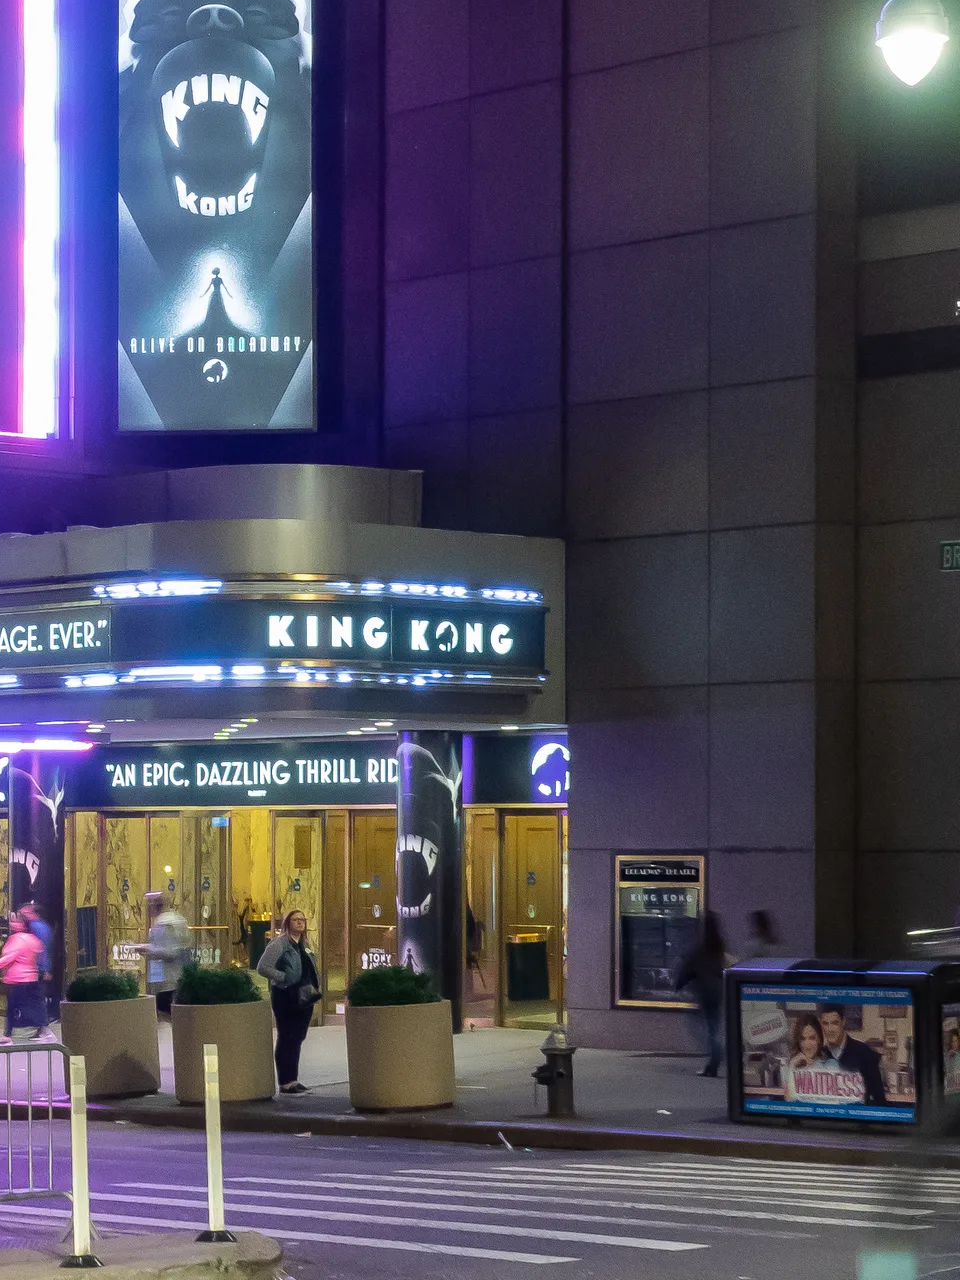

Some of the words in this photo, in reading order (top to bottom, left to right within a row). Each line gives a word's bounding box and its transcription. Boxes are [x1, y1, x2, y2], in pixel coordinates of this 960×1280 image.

[160, 72, 270, 150] KING
[174, 171, 258, 218] KONG
[130, 337, 175, 353] ALIVE
[187, 337, 205, 353] ON
[216, 336, 302, 353] BROADWAY
[268, 615, 389, 649] KING
[410, 620, 515, 655] KONG
[142, 762, 190, 789] EPIC,
[196, 759, 291, 786] DAZZLING
[296, 758, 361, 783] THRILL
[630, 893, 658, 902] KING
[662, 893, 694, 902] KONG
[369, 953, 392, 964] TONY
